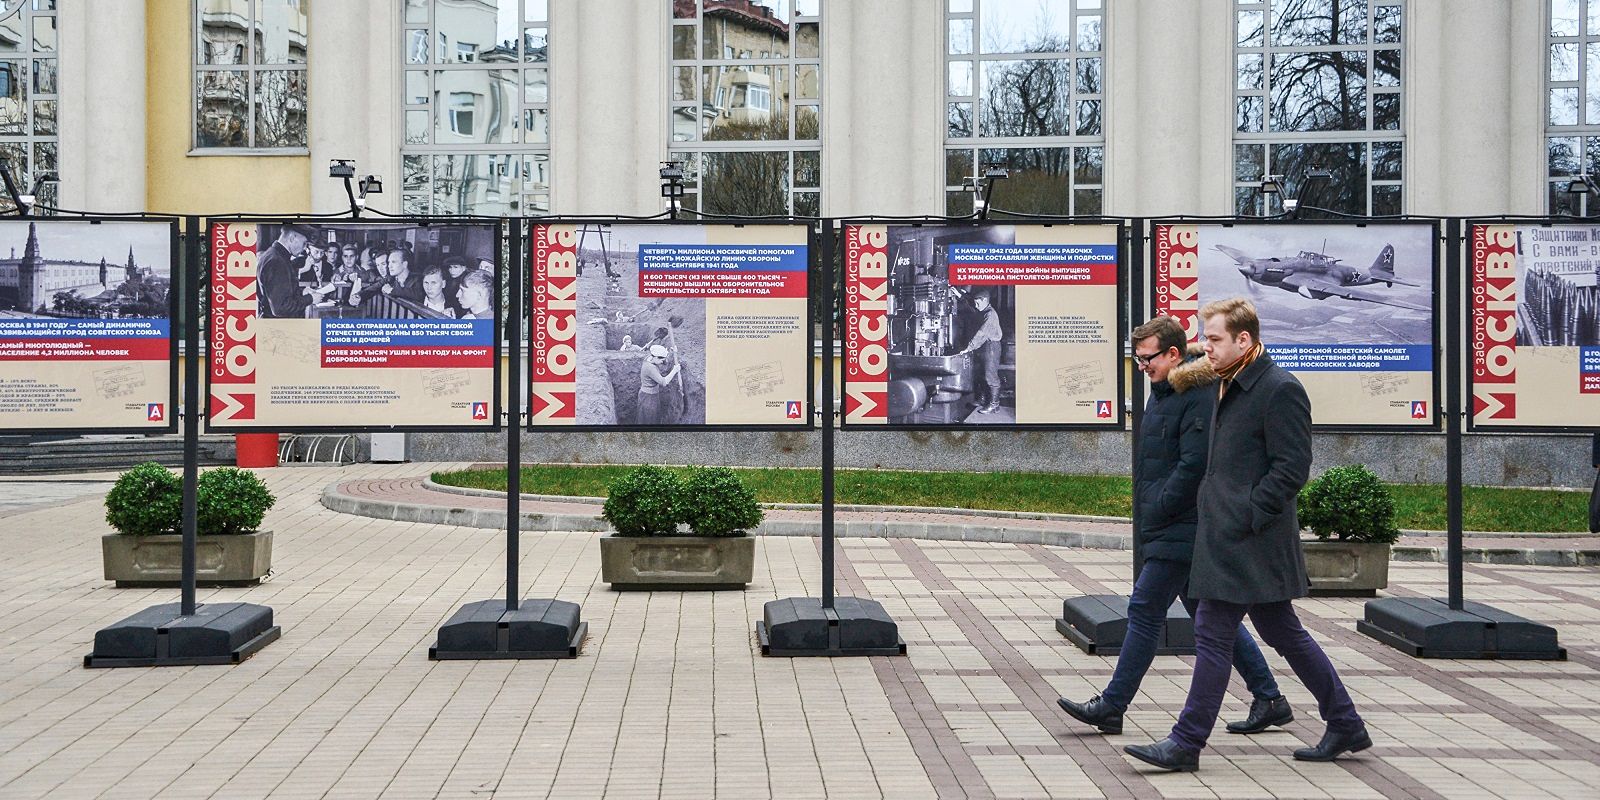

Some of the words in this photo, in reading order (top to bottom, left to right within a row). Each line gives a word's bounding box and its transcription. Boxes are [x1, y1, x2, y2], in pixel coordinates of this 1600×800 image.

[216, 223, 228, 281] истории
[537, 223, 549, 281] истории
[849, 224, 860, 281] истории
[1159, 224, 1171, 282] истории
[1476, 224, 1488, 282] истории
[213, 284, 224, 302] об
[534, 285, 546, 302] об
[846, 285, 858, 303] об
[1156, 285, 1168, 303] об
[1473, 285, 1485, 303] об
[210, 224, 256, 426] Москва
[212, 307, 224, 365] заботой
[532, 224, 576, 426] Москва
[533, 307, 546, 364] заботой
[846, 225, 887, 424] Москва
[846, 308, 858, 363] заботой
[1473, 225, 1516, 425] Москва
[1473, 308, 1485, 364] заботой
[216, 368, 224, 377] с
[536, 367, 546, 376] с
[849, 367, 858, 375] с
[1476, 368, 1484, 376] с
